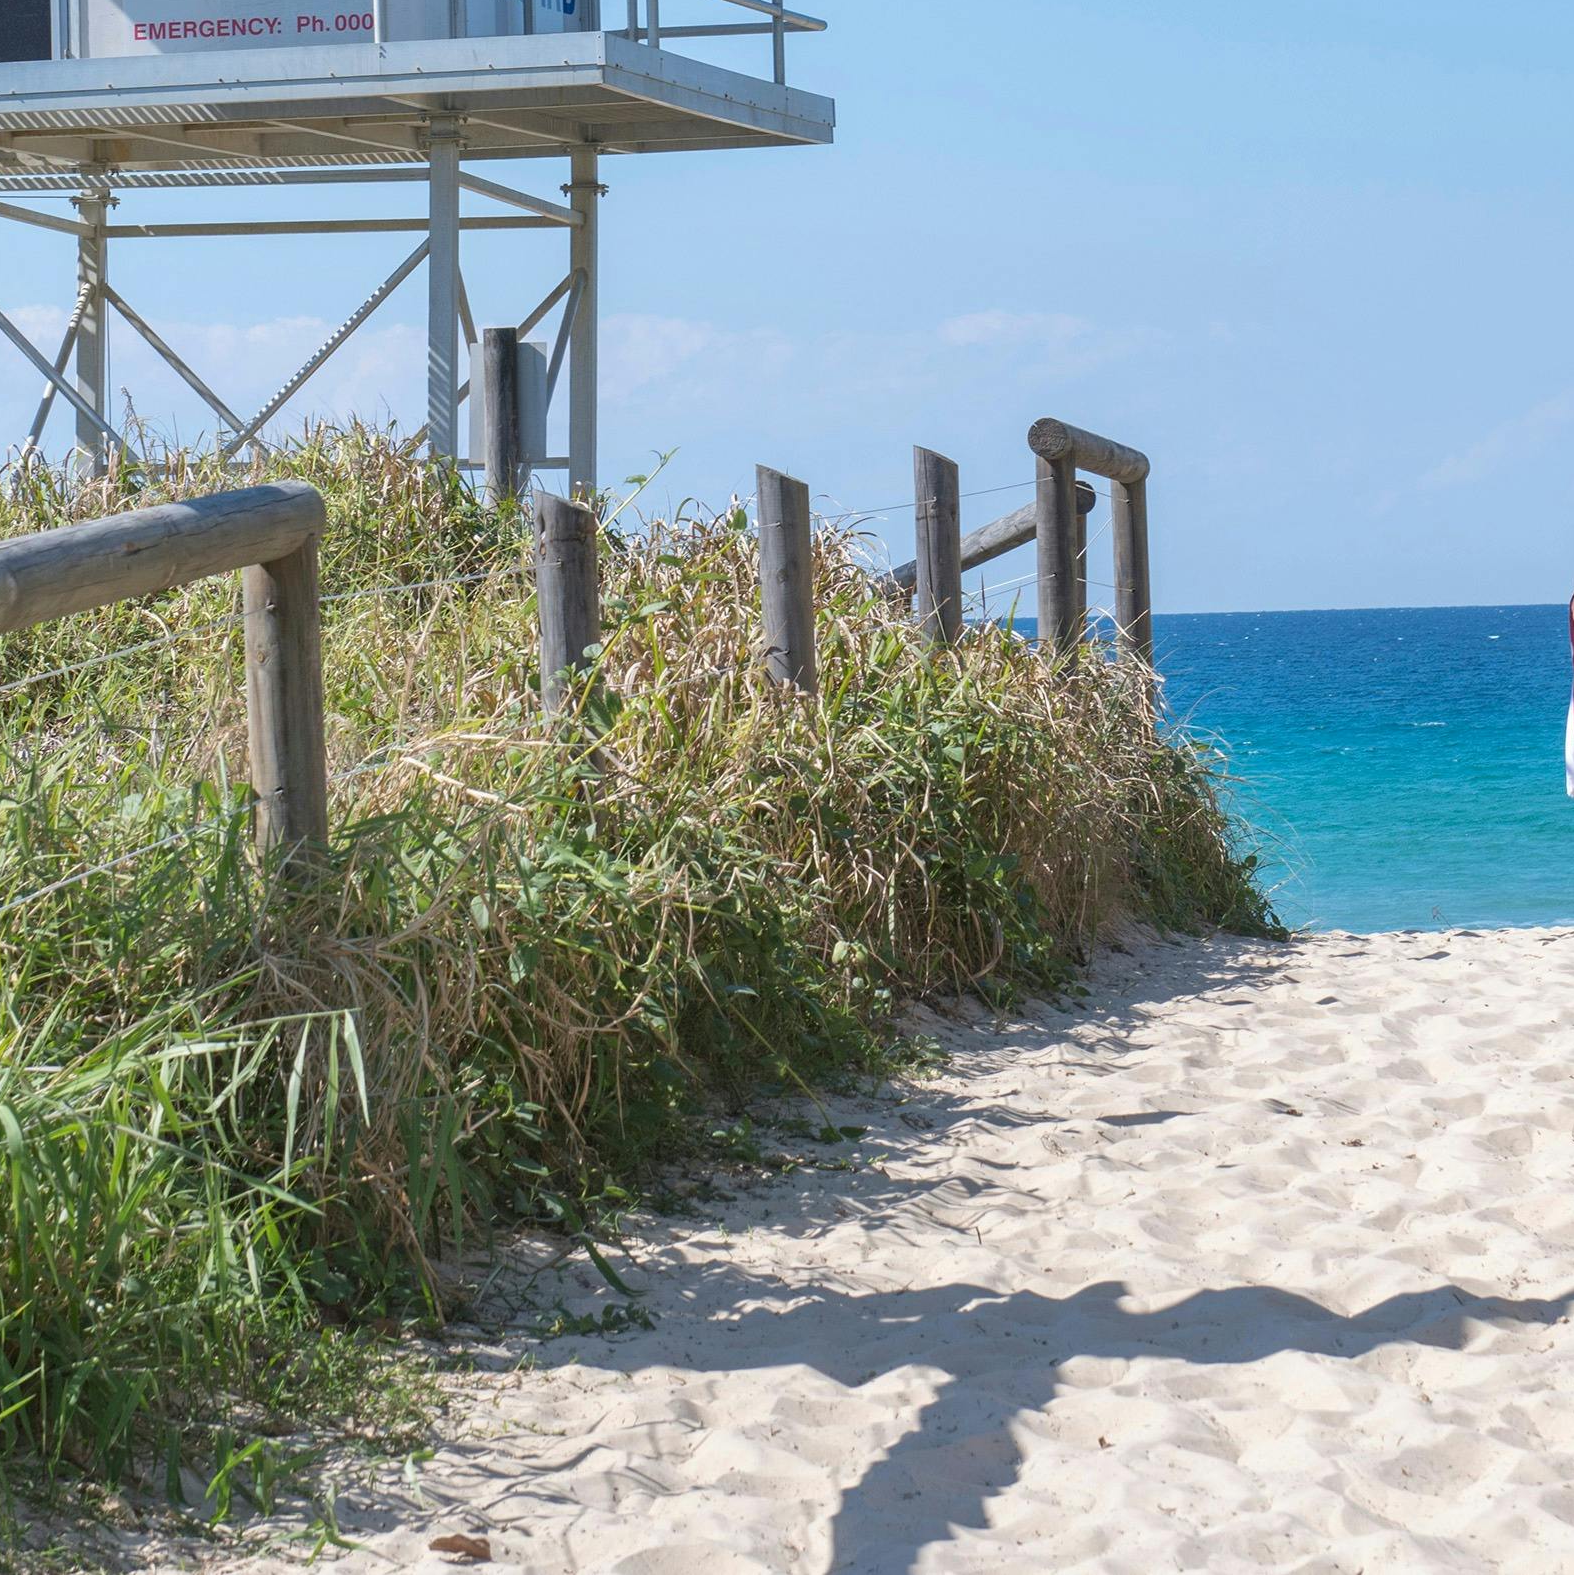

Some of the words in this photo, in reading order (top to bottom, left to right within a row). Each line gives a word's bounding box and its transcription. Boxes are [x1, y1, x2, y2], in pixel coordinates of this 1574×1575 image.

[134, 17, 281, 41] EMERGENCY:
[296, 15, 330, 32] Ph.
[335, 13, 374, 31] 000
